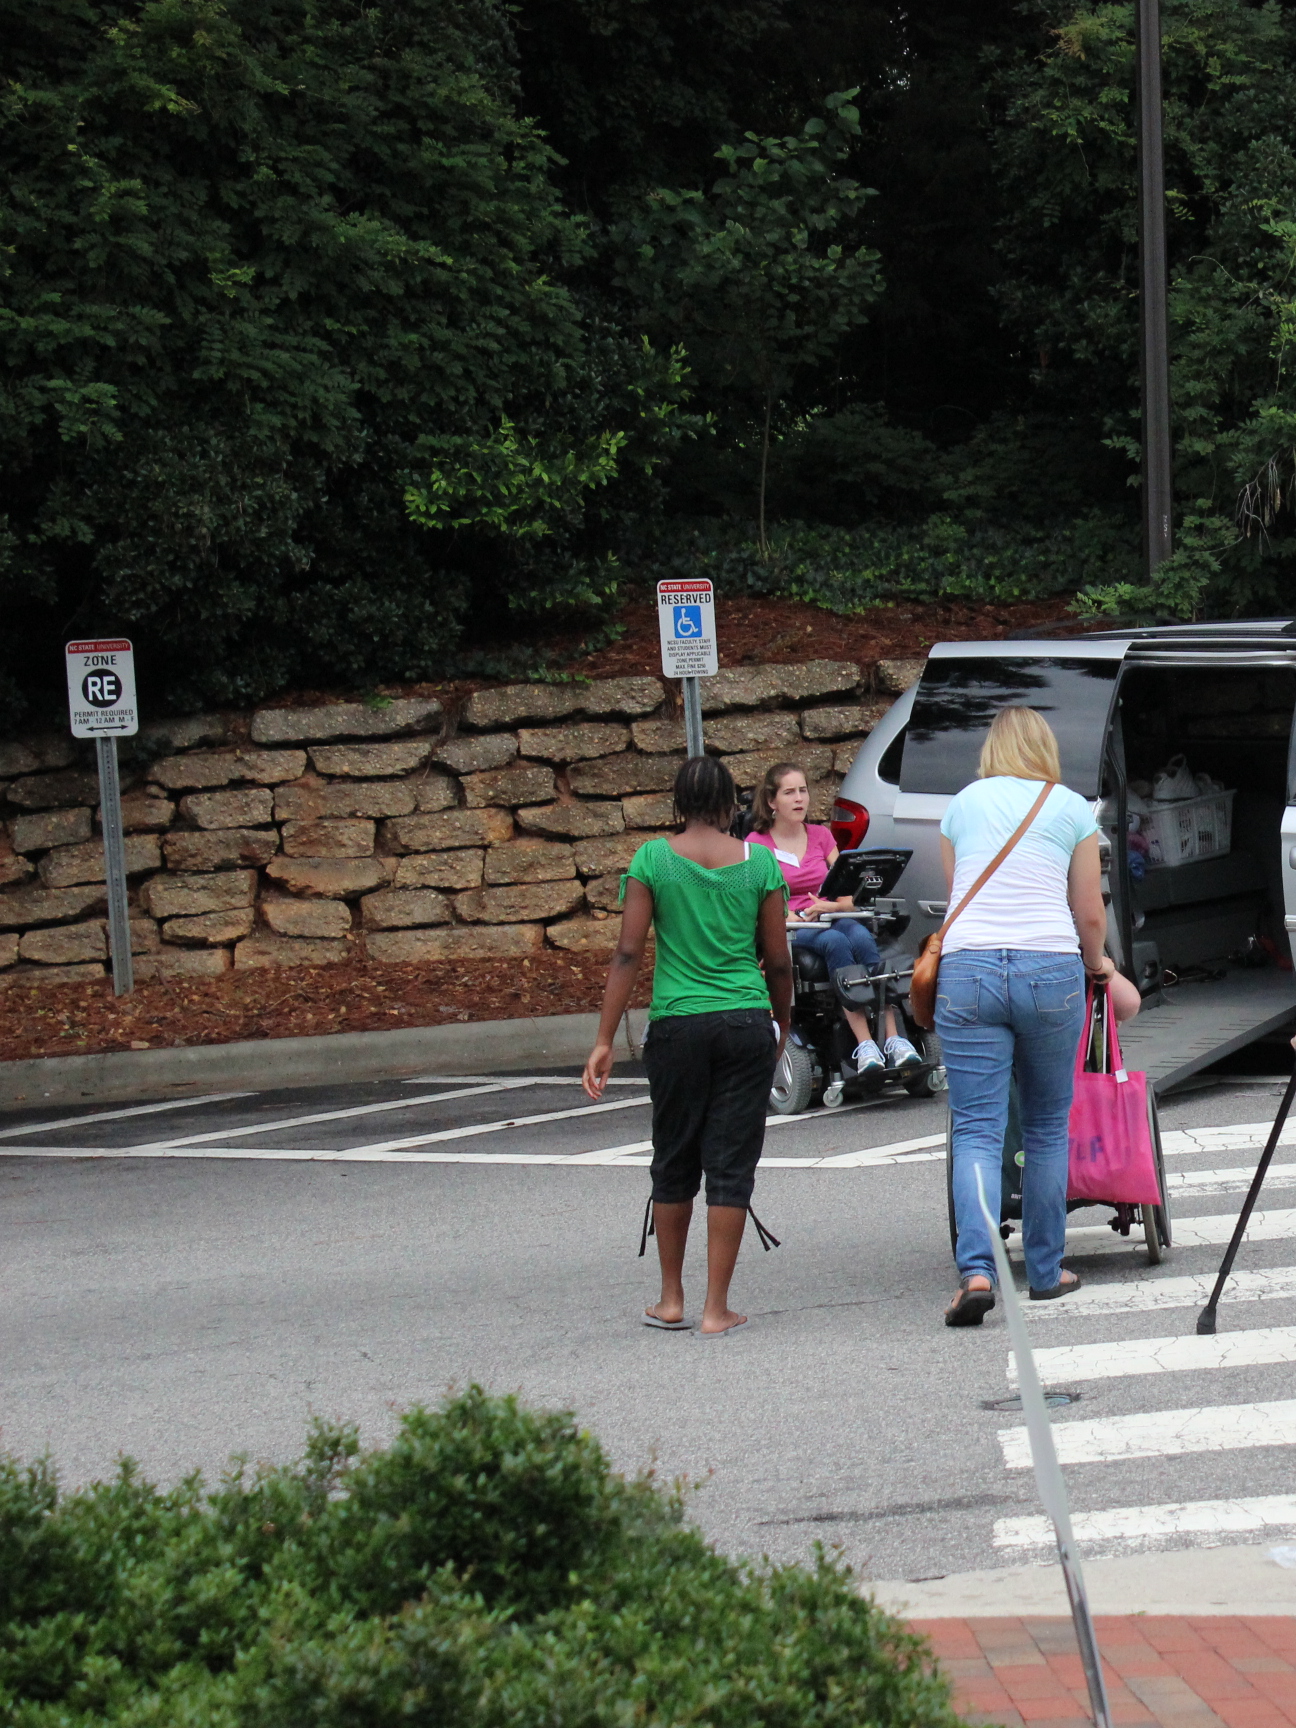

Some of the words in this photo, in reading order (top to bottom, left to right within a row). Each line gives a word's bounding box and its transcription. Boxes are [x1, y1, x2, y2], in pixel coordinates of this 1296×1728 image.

[661, 593, 711, 605] RESERVED
[84, 655, 117, 666] ZONE
[87, 676, 117, 700] RE
